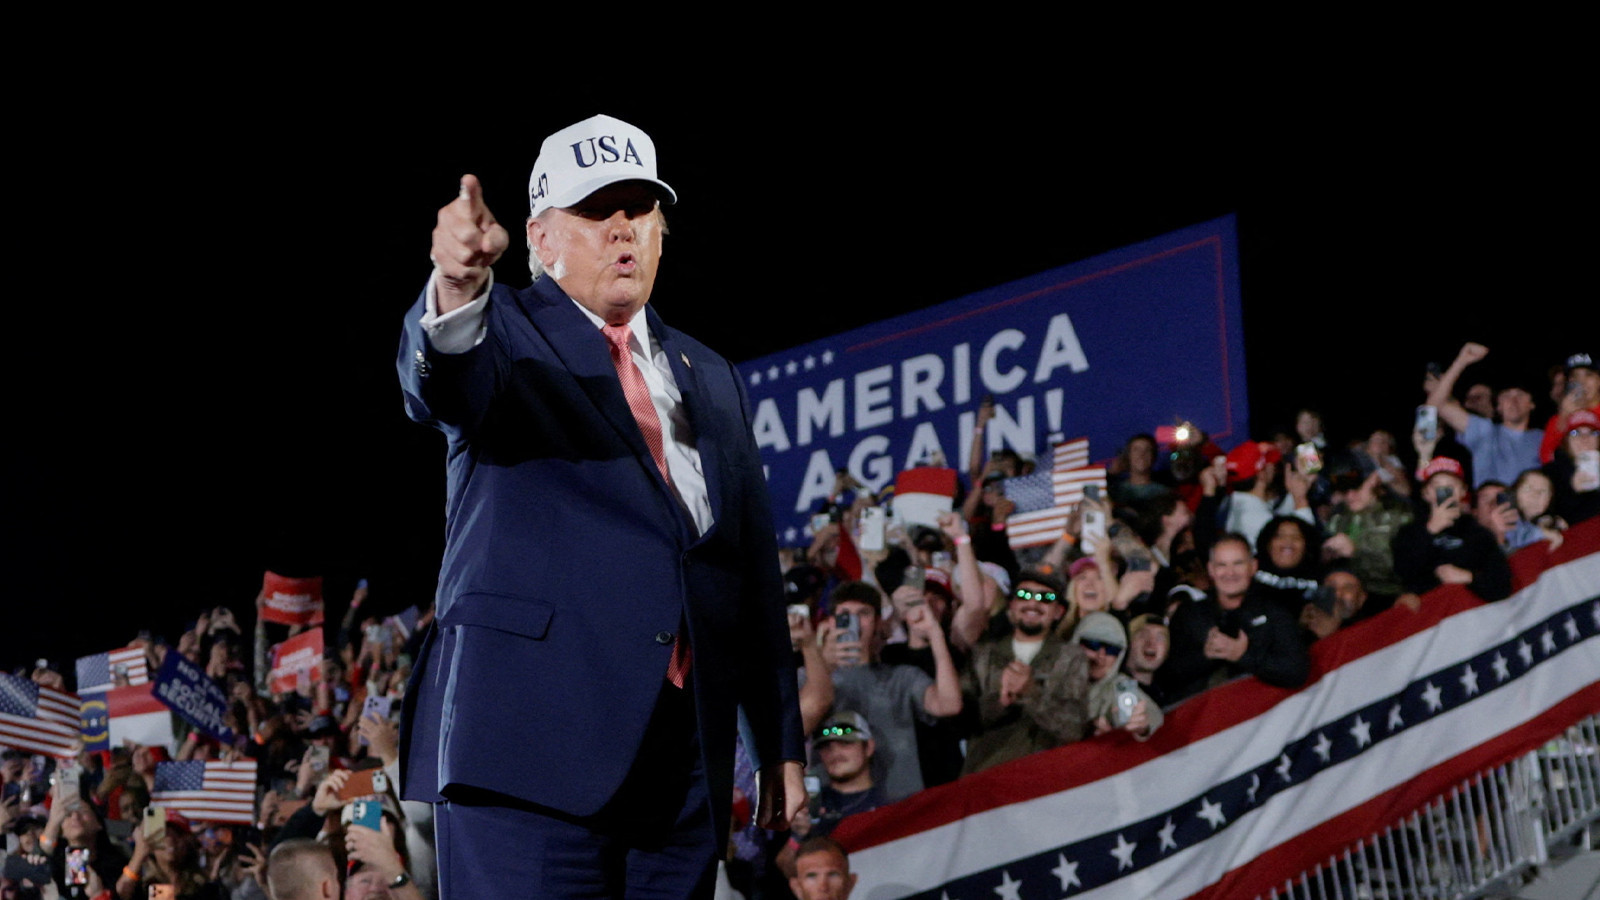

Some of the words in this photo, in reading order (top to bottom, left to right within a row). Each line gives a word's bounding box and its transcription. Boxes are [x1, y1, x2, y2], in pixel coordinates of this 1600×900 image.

[570, 135, 643, 168] USA
[752, 313, 1089, 452] AMERICA
[795, 388, 1064, 512] AGAIN!
